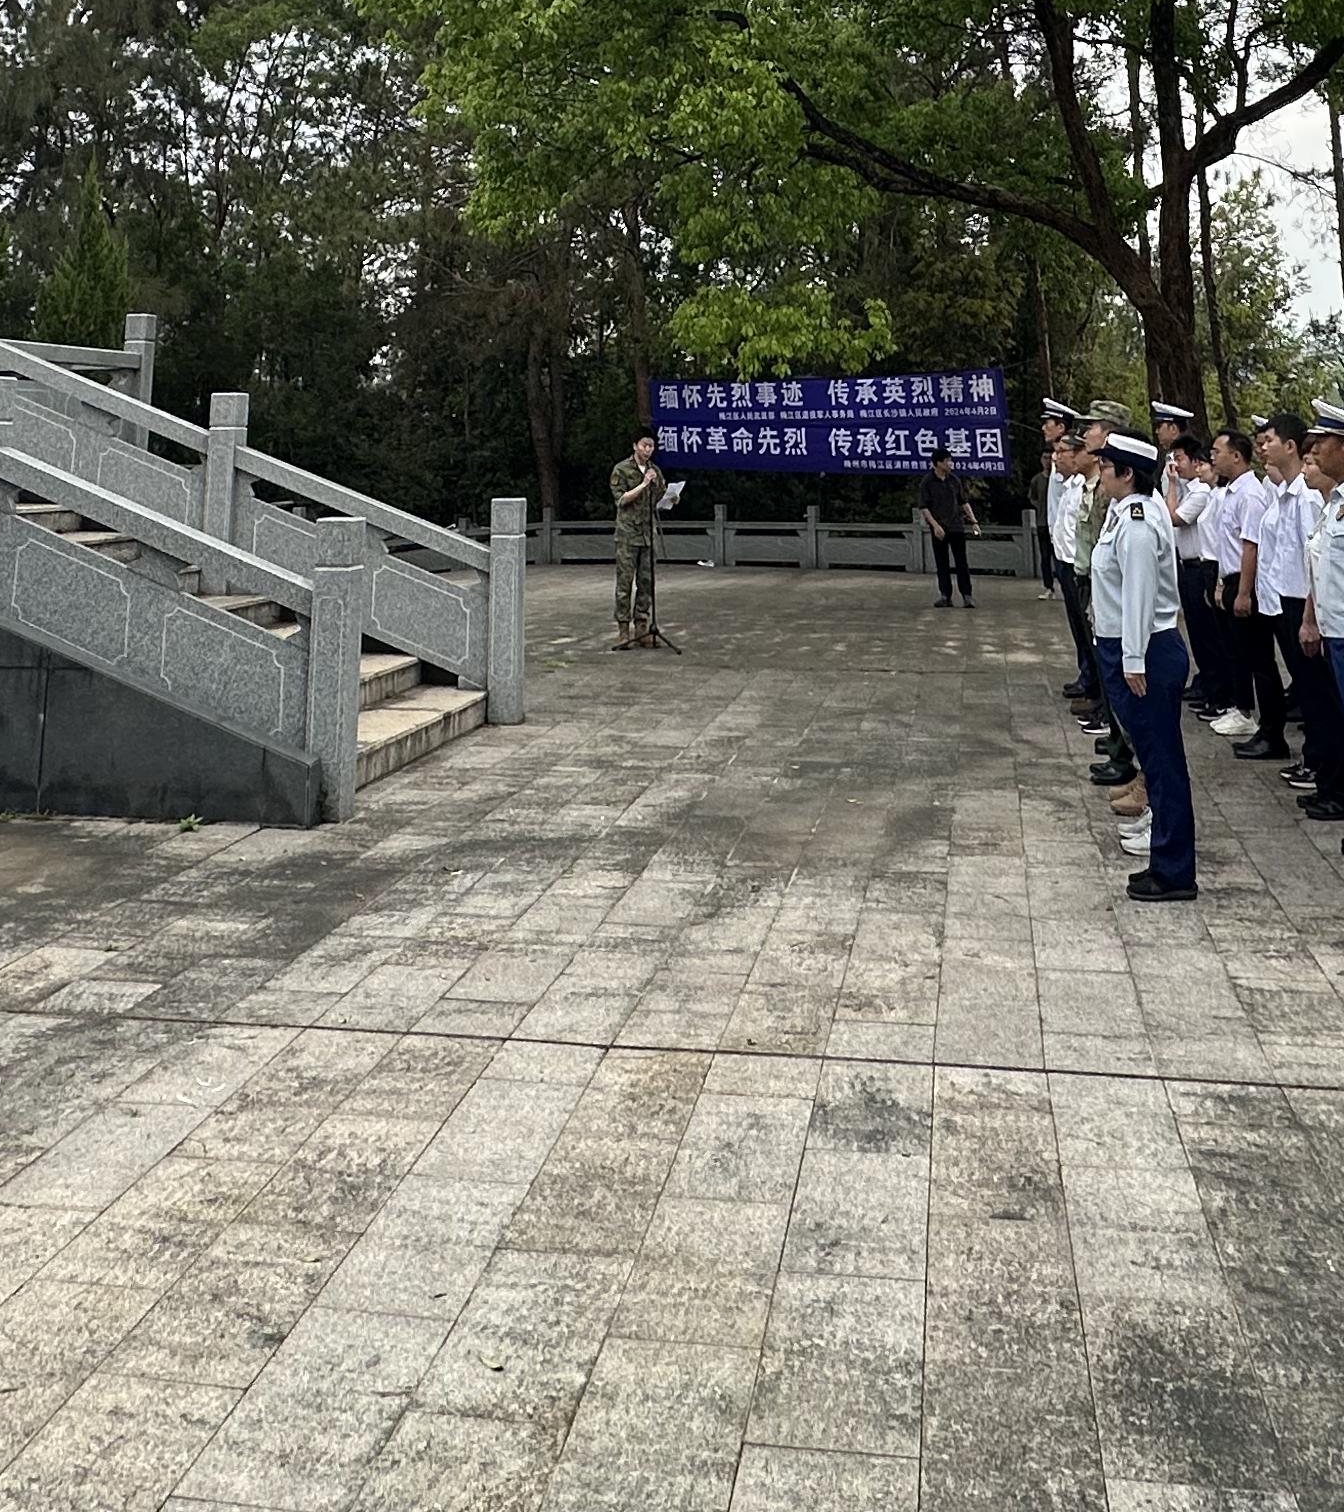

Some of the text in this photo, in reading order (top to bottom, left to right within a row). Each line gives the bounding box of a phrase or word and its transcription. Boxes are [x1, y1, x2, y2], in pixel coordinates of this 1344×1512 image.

[658, 374, 995, 409] 缅怀先烈事迹 传承英烈精神
[944, 406, 997, 417] 2024年4月2日
[657, 425, 1004, 458] 缅怀革命先烈 传承红色基因
[843, 460, 935, 471] 梅州市梅江区消防救援大
